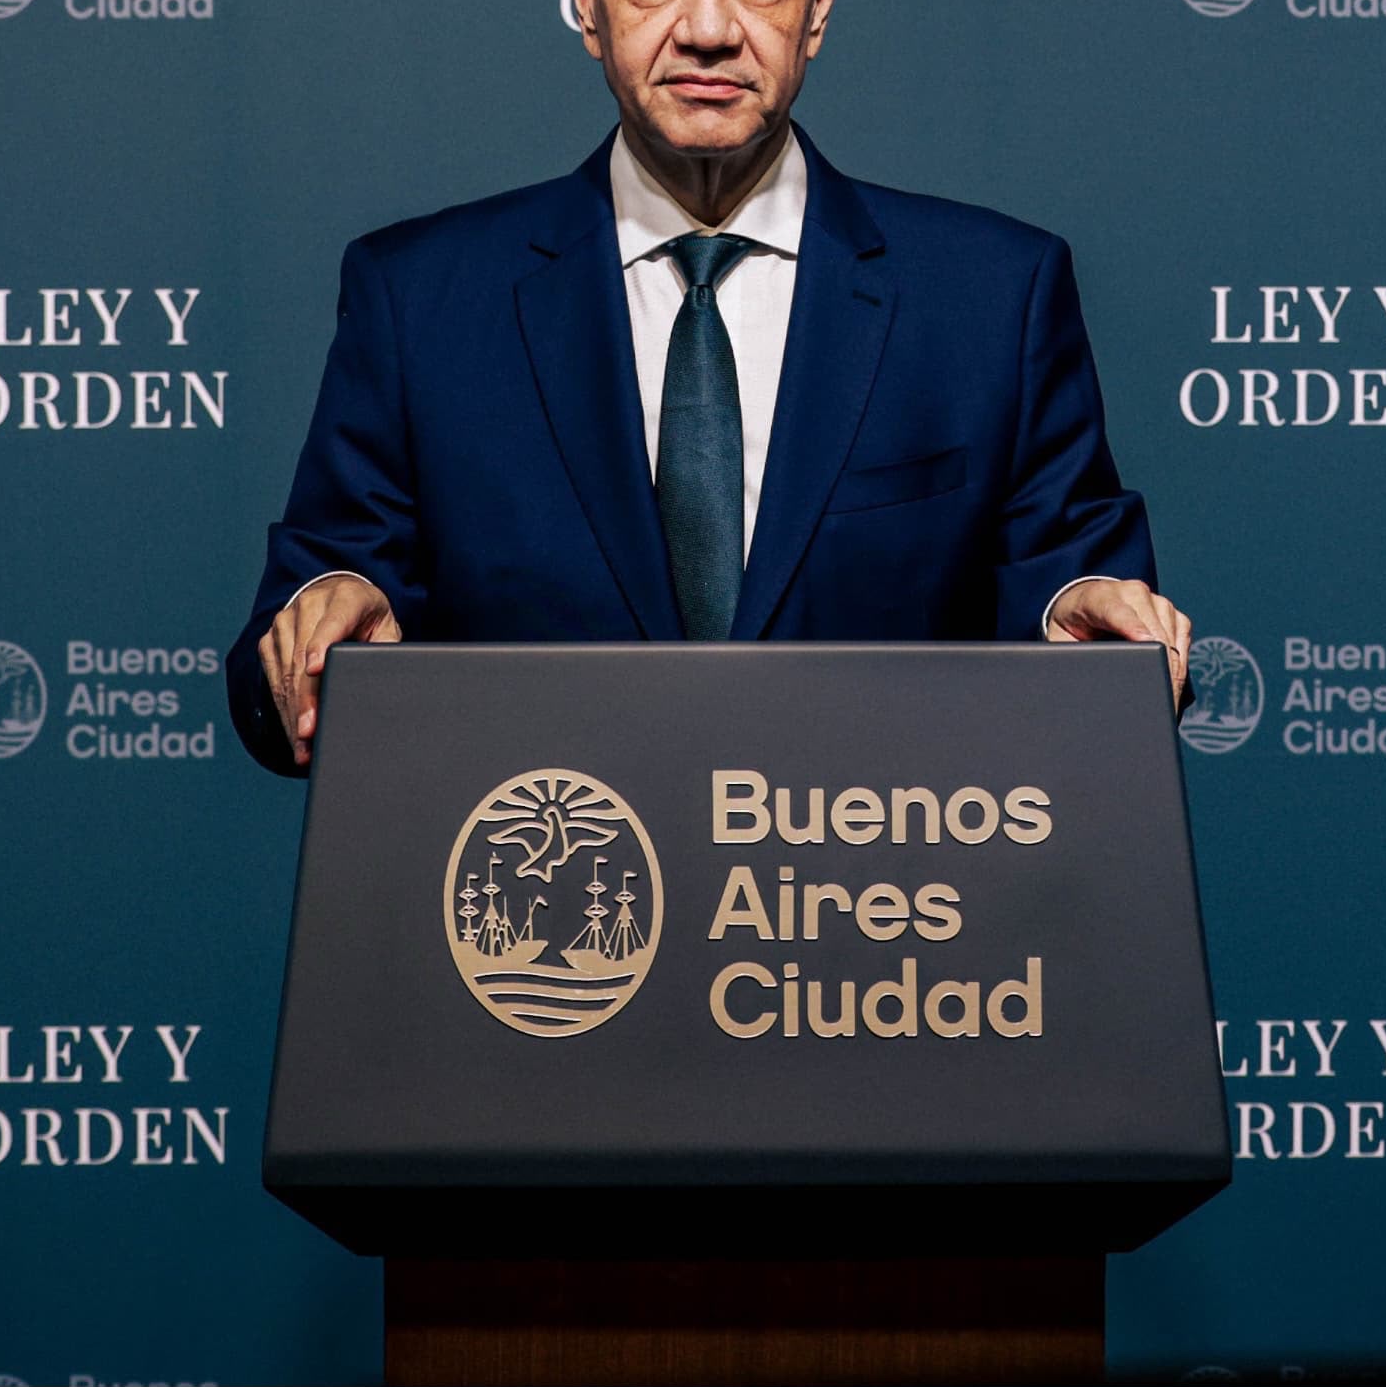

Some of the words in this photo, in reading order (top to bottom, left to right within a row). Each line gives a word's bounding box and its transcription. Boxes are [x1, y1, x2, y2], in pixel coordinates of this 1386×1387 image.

[153, 287, 201, 346] Y
[1210, 285, 1352, 344] LEY
[67, 640, 219, 675] Buenos
[66, 682, 180, 716] Aires
[66, 722, 214, 759] Ciudad
[711, 769, 1053, 846] Buenos
[707, 865, 963, 942] Aires
[709, 956, 1044, 1039] Ciudad
[155, 1024, 202, 1083] Y
[1215, 1019, 1348, 1077] LEY
